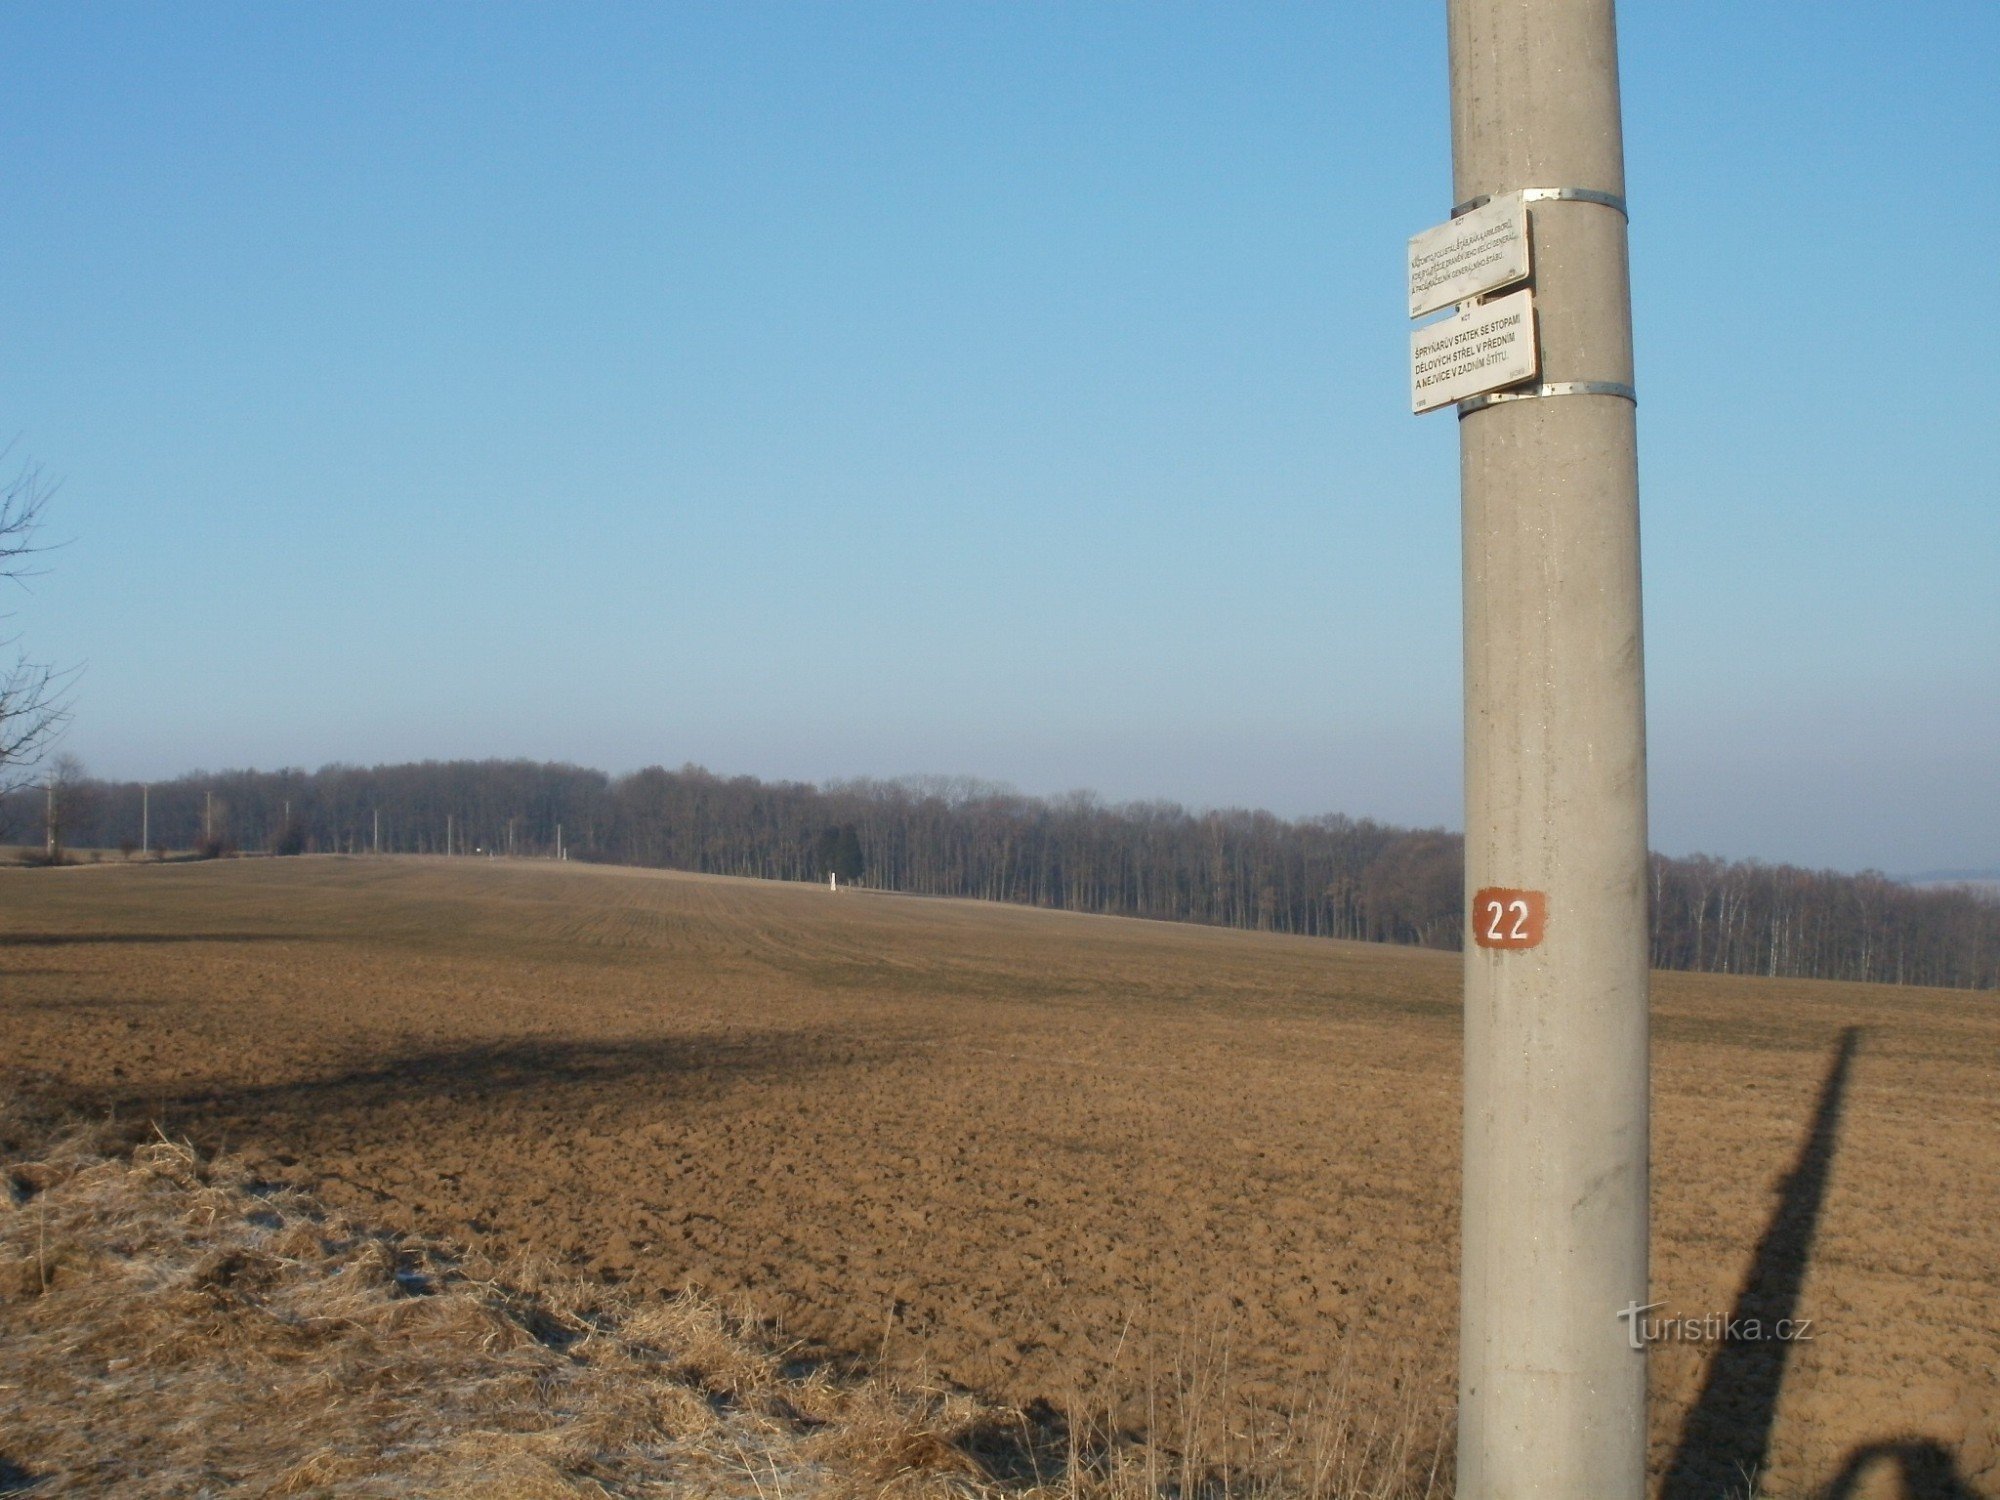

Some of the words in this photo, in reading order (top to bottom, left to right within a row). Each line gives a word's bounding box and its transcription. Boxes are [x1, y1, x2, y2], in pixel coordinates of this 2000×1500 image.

[1455, 328, 1479, 345] STATEK
[1480, 324, 1490, 336] SE
[1490, 313, 1521, 332] STOPAMI
[1453, 346, 1475, 362] STŘEL
[1476, 343, 1481, 353] V
[1482, 331, 1515, 351] PŘEDNÍM
[1416, 380, 1421, 390] A
[1451, 367, 1457, 377] V
[1487, 900, 1528, 939] 22
